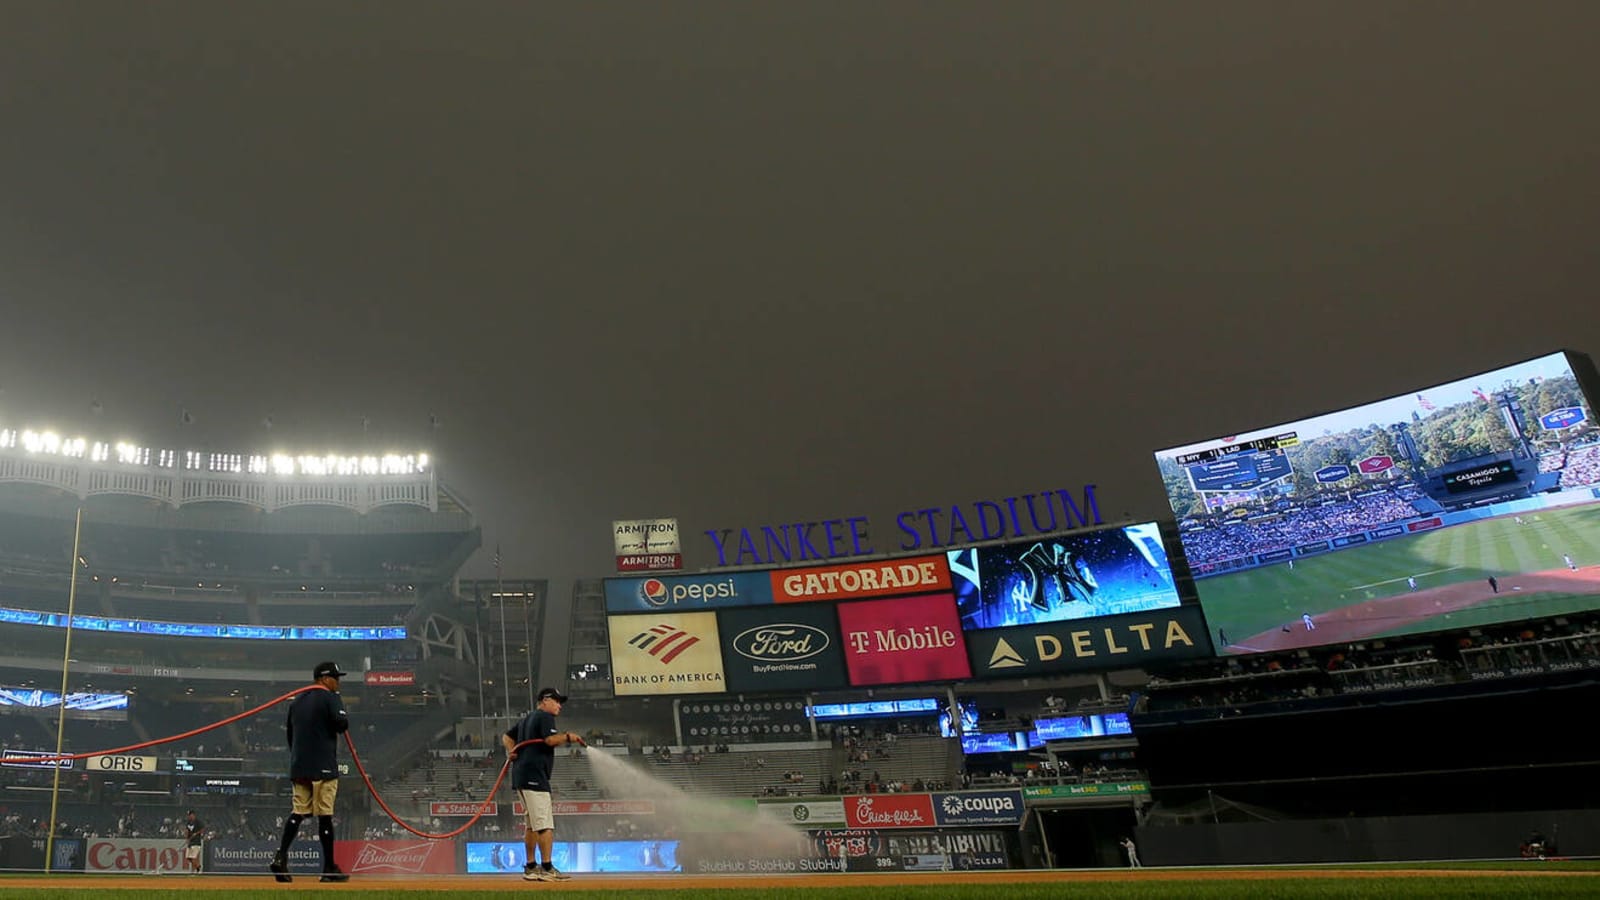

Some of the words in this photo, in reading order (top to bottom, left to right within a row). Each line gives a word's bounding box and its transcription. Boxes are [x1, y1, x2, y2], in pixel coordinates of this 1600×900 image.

[1456, 466, 1500, 482] CASAMIGOS
[616, 523, 675, 534] ARMITRON
[705, 516, 874, 566] YANKEE
[896, 484, 1103, 550] STADIUM
[622, 555, 676, 566] ARMITRON
[783, 562, 938, 597] GATORADE
[672, 577, 738, 604] pepsi
[750, 629, 812, 656] Ford
[876, 627, 956, 653] Mobile
[1034, 620, 1194, 662] DELTA
[753, 662, 817, 673] BuyFordNow.com
[616, 675, 648, 685] BANK
[650, 674, 665, 684] OF
[667, 672, 722, 683] AMERICA
[100, 756, 144, 770] ORIS
[964, 797, 1014, 814] coupa
[856, 801, 925, 826] Chick-fil-A
[214, 848, 274, 859] Montefiore
[361, 849, 426, 864] Budweiser
[749, 859, 796, 872] StubHub
[876, 858, 892, 867] 399
